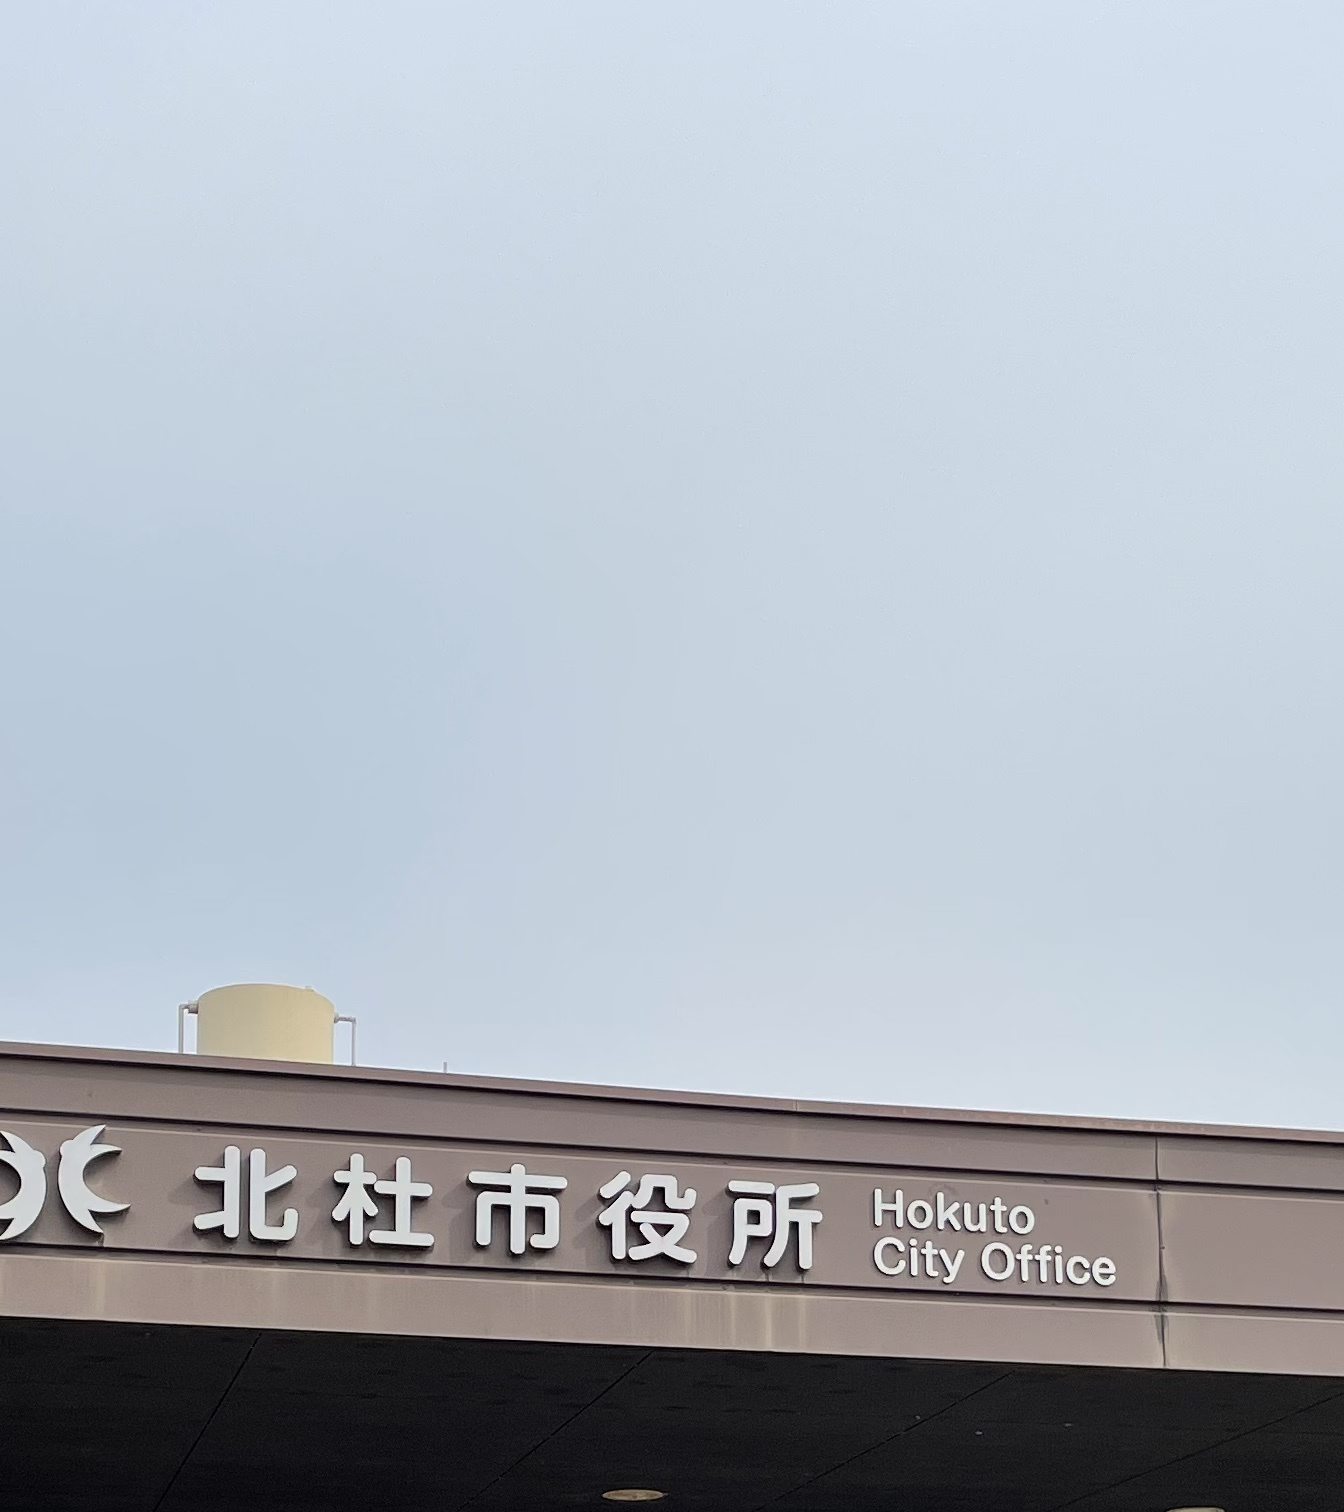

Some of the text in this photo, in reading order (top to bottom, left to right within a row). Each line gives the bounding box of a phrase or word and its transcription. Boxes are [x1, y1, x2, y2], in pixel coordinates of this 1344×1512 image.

[193, 1145, 823, 1273] 北杜市役所
[873, 1188, 1036, 1236] Hokuto
[873, 1237, 1118, 1288] City Office
